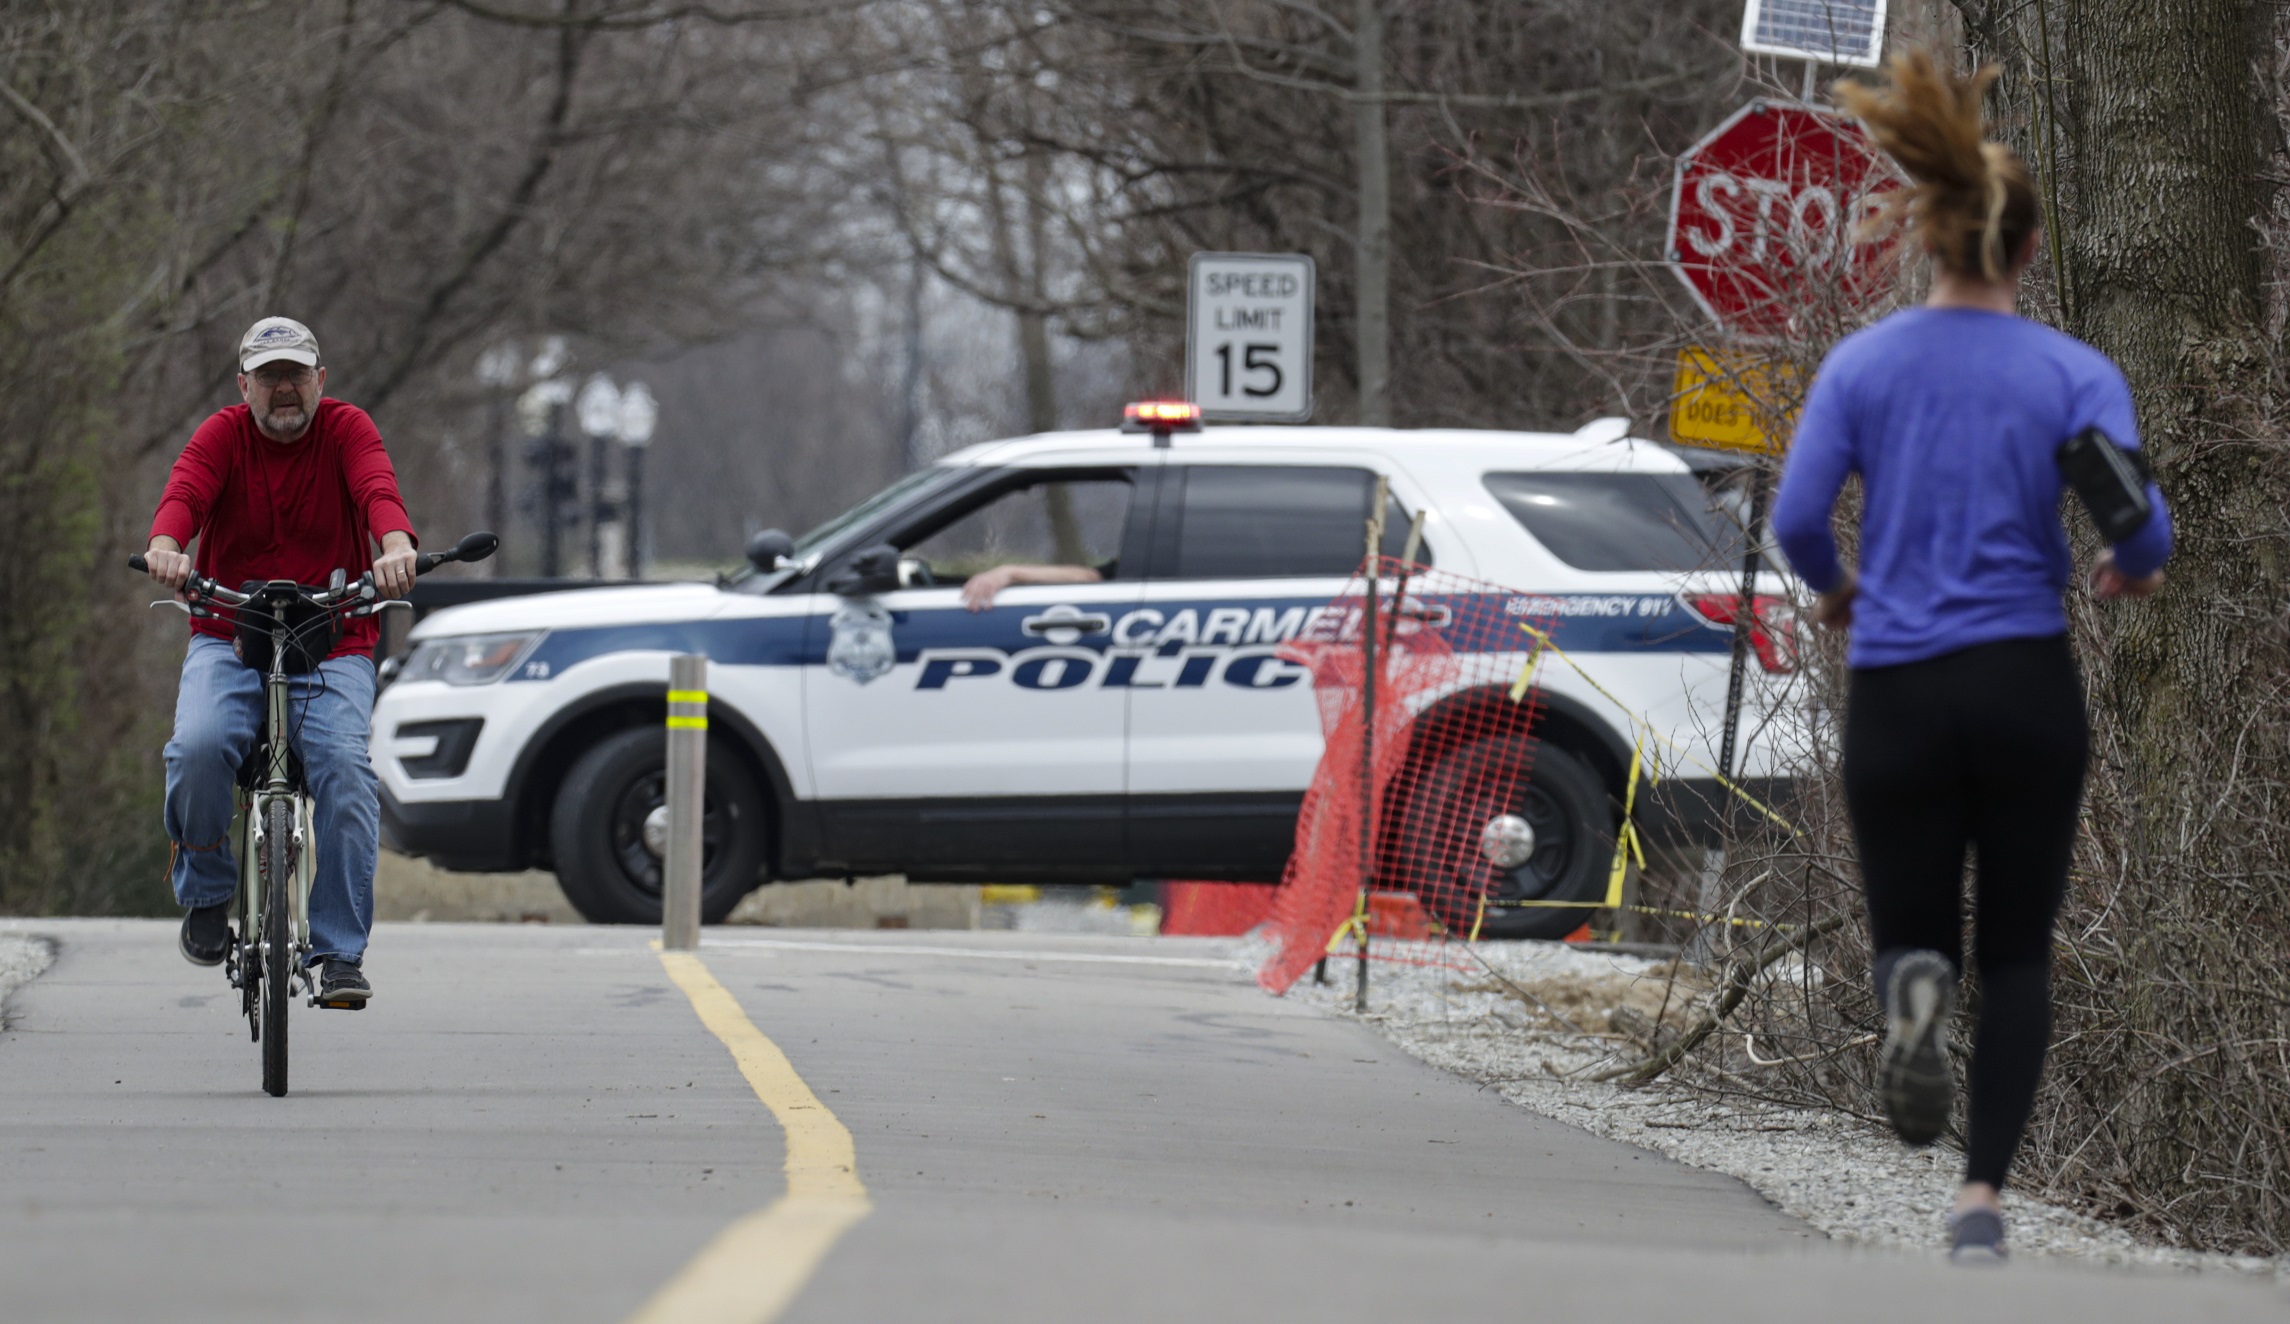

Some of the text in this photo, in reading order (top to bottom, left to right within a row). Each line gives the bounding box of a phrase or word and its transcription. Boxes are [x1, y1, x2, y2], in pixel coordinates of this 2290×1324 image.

[1206, 272, 1299, 298] SPEED
[1215, 306, 1284, 332] LIMIT
[1215, 341, 1284, 398] 15
[1687, 399, 1739, 427] DOES
[1637, 597, 1673, 617] 911
[1112, 607, 1364, 646] CARMEL
[913, 647, 1345, 691] POLIC
